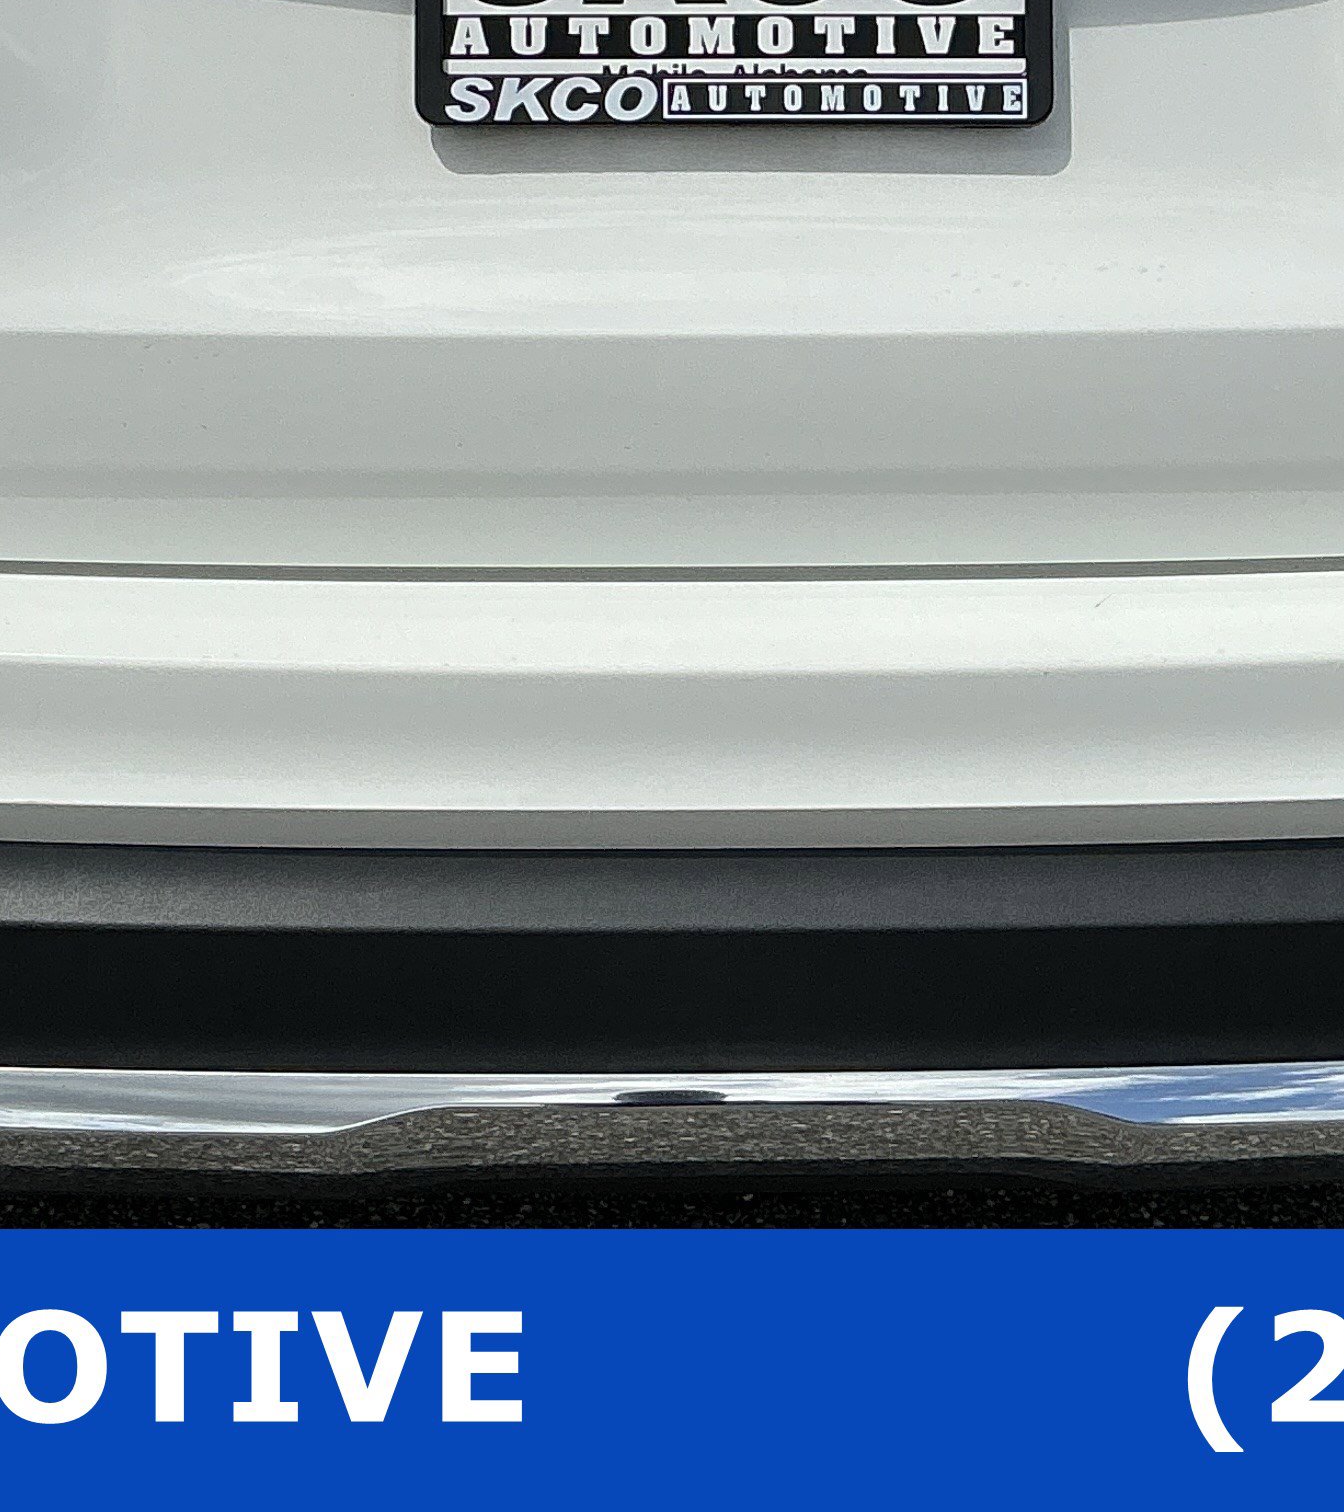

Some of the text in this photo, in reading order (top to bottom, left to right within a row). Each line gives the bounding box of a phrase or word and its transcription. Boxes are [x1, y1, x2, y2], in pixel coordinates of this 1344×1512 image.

[450, 16, 1016, 57] AUTOMOTIVE
[444, 76, 1024, 123] SKCO AUTOMOTIVE
